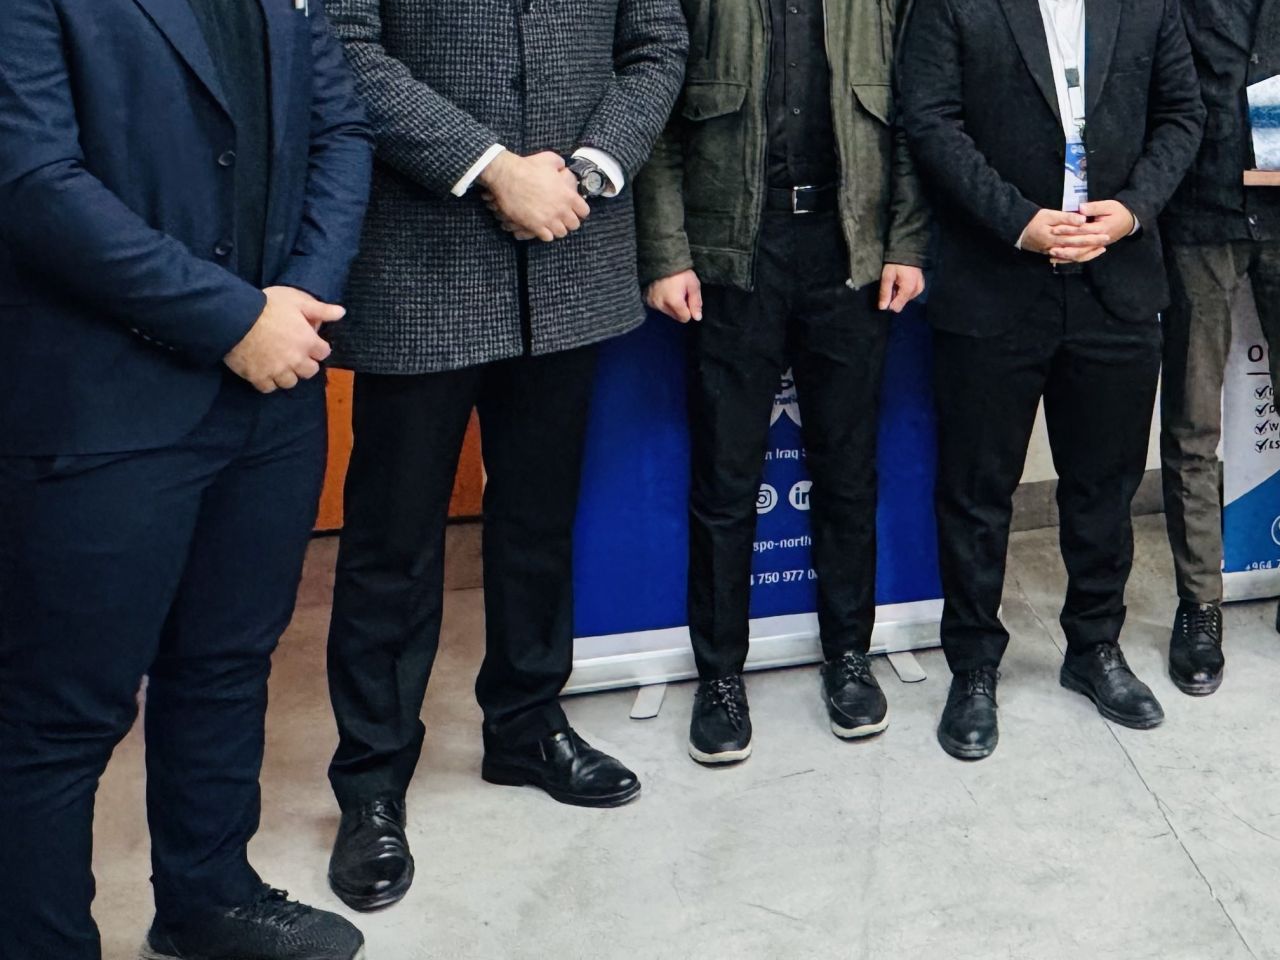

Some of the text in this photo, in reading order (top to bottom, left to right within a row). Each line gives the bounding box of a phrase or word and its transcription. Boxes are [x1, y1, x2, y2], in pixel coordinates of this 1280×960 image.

[776, 448, 799, 460] Iraq
[757, 572, 780, 585] 750
[782, 569, 805, 582] 977
